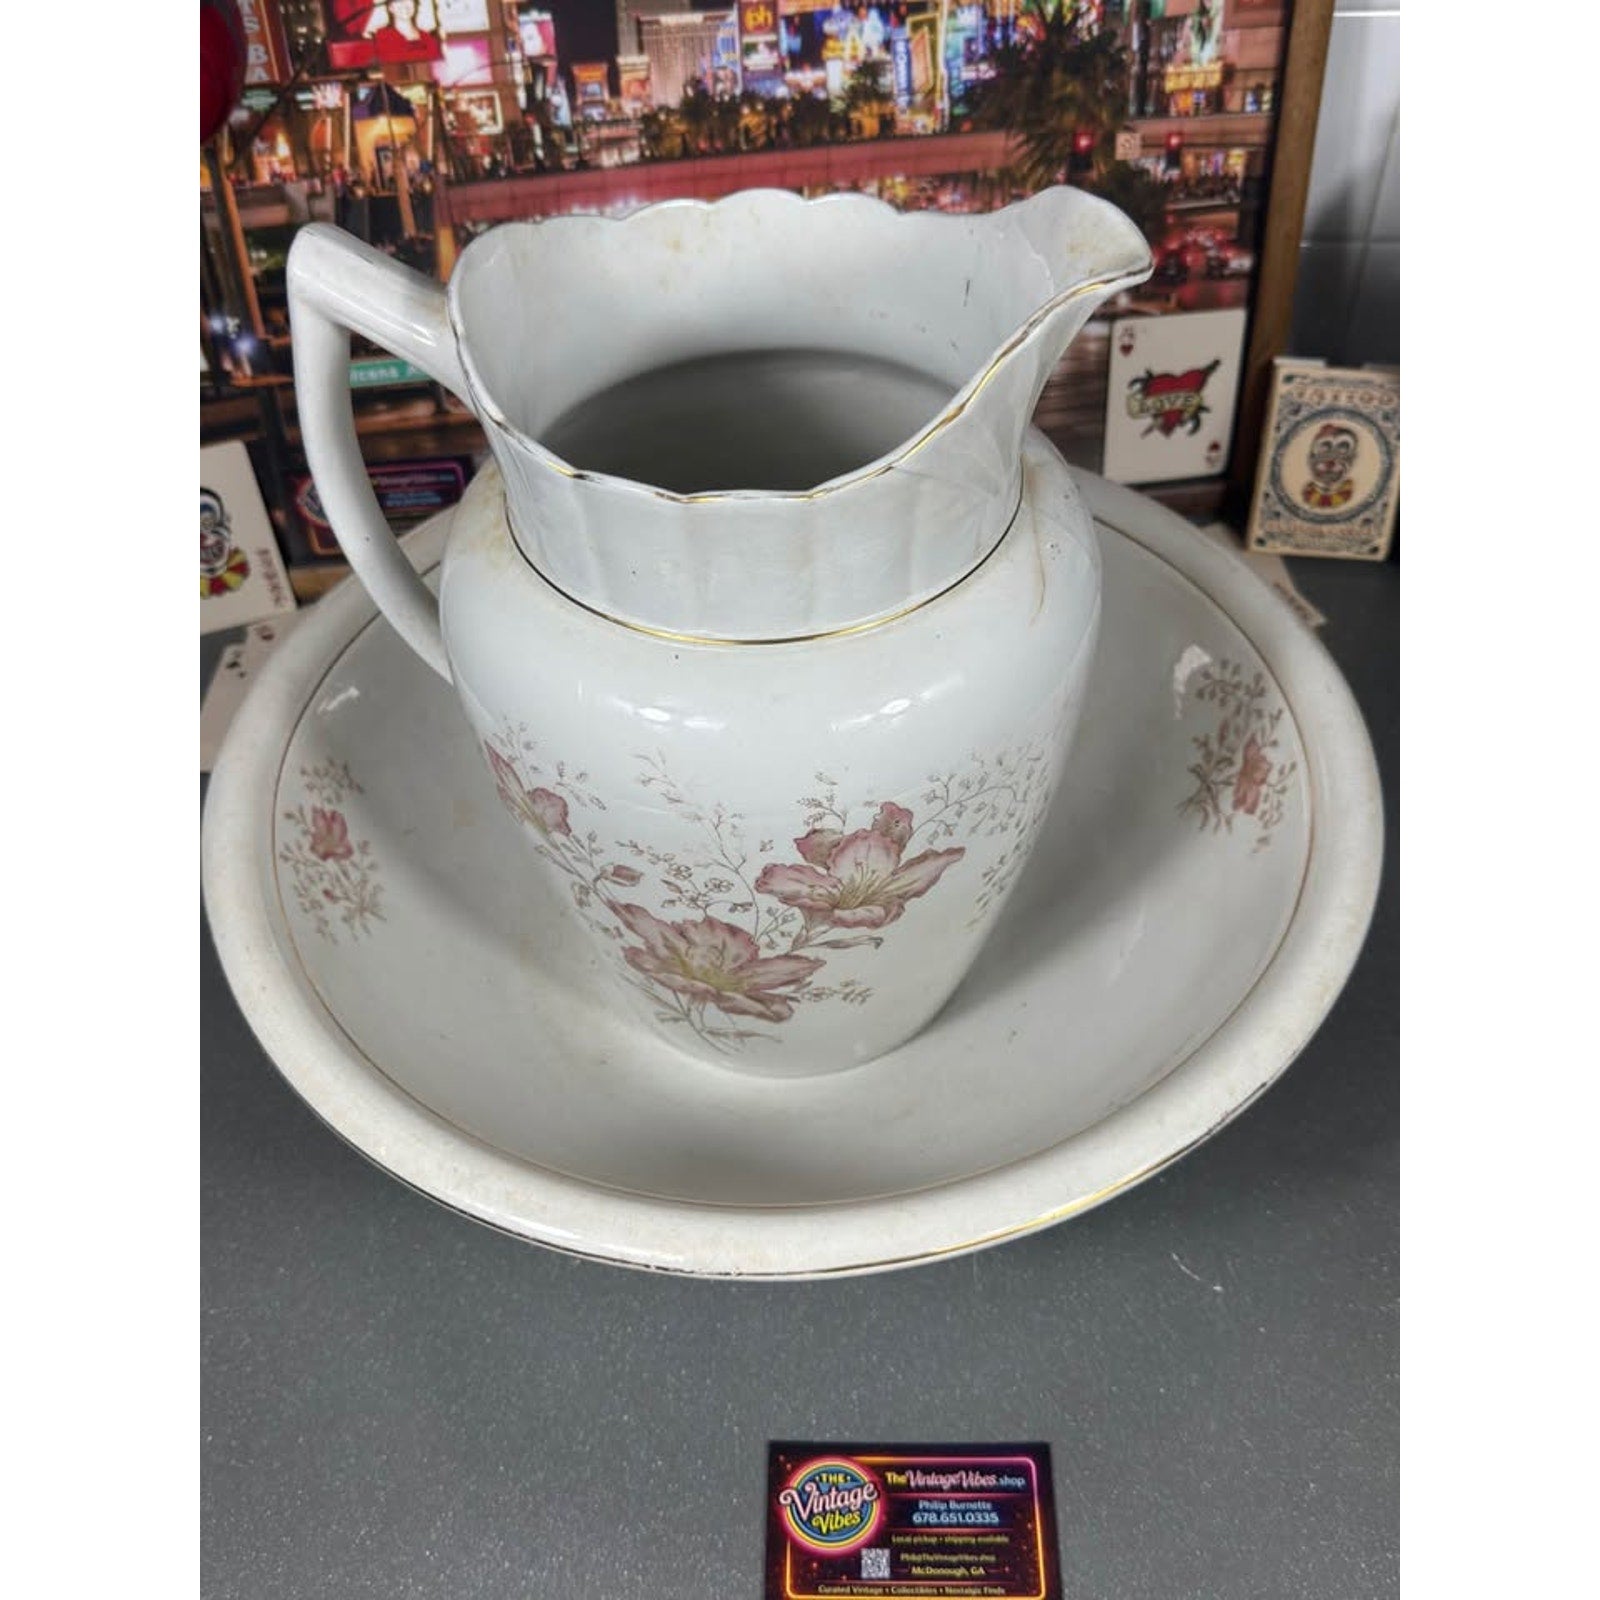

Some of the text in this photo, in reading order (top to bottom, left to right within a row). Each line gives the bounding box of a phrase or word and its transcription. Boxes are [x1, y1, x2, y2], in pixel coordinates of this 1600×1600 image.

[821, 1473, 846, 1484] THE
[779, 1482, 878, 1522] Vintage
[811, 1509, 861, 1534] Vibes
[912, 1511, 1000, 1524] 678.651.0335
